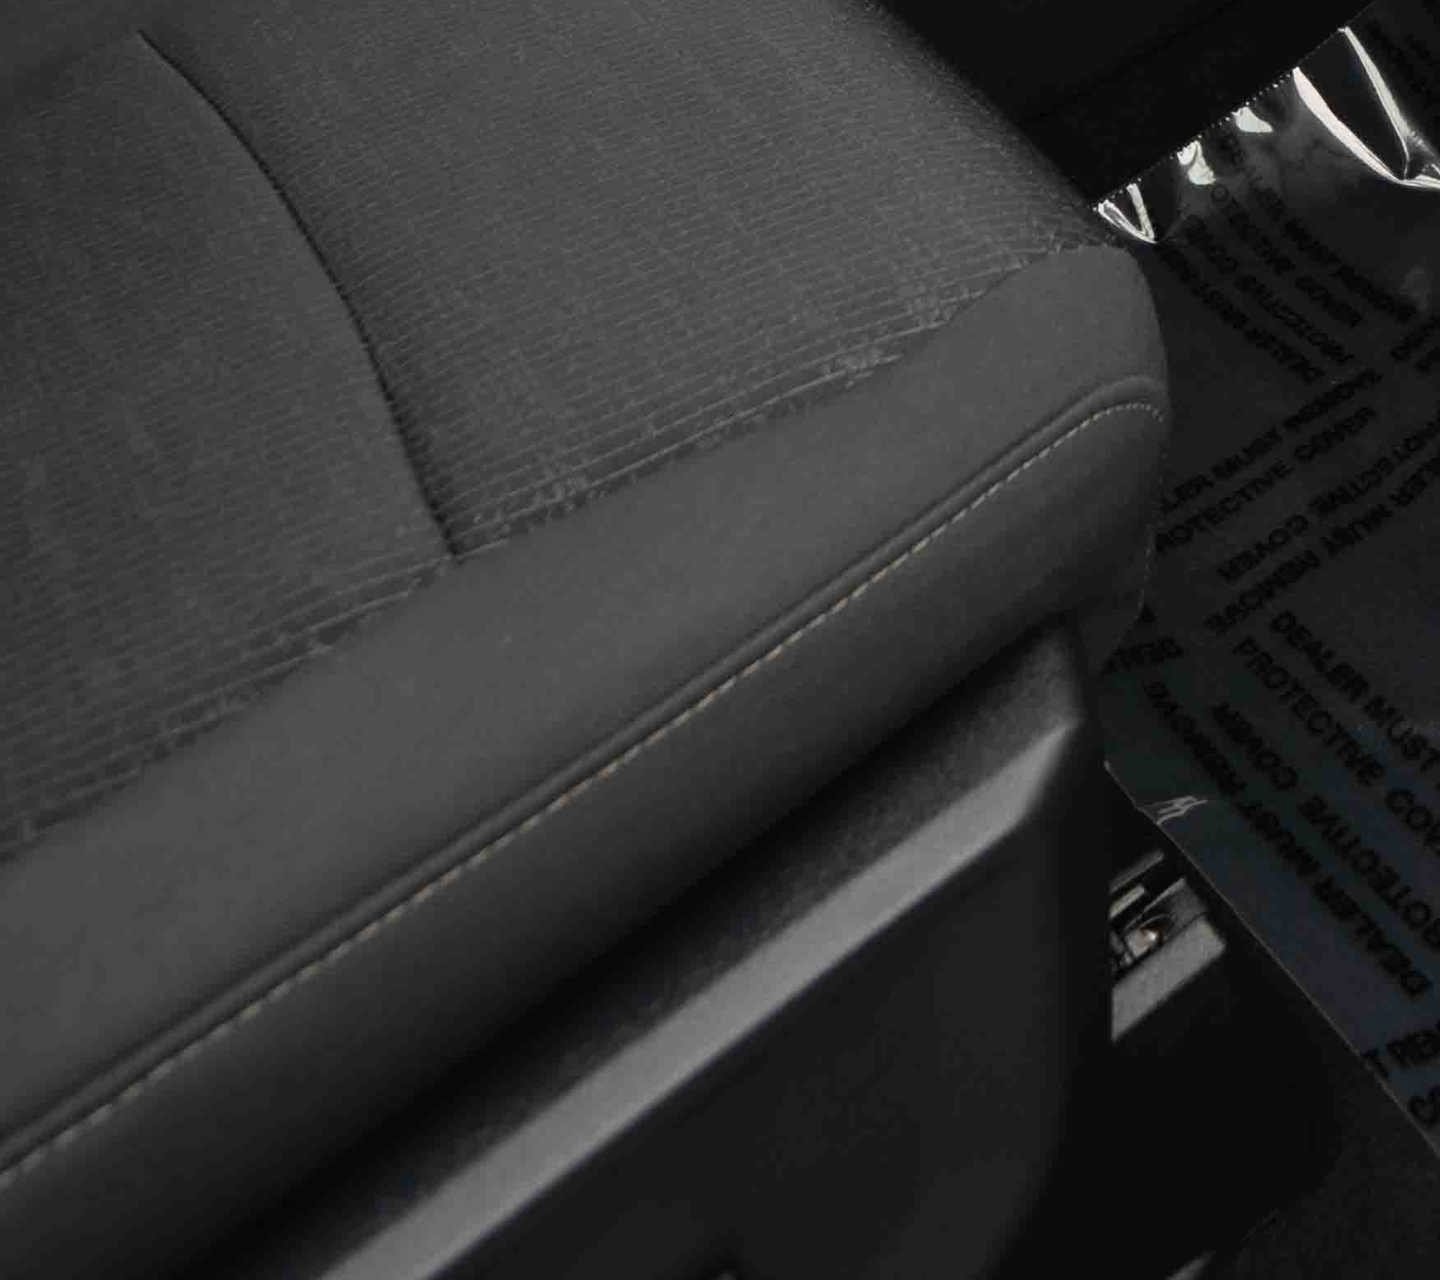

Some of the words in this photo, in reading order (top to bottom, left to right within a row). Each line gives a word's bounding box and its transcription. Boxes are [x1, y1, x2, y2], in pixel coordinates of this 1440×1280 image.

[1270, 609, 1370, 701] DEALER
[1142, 680, 1247, 796] REMOVE
[1211, 702, 1298, 790] COVER
[1233, 636, 1386, 786] PROTECTIVE
[1237, 800, 1321, 877] MUST
[1314, 877, 1432, 996] DEALER
